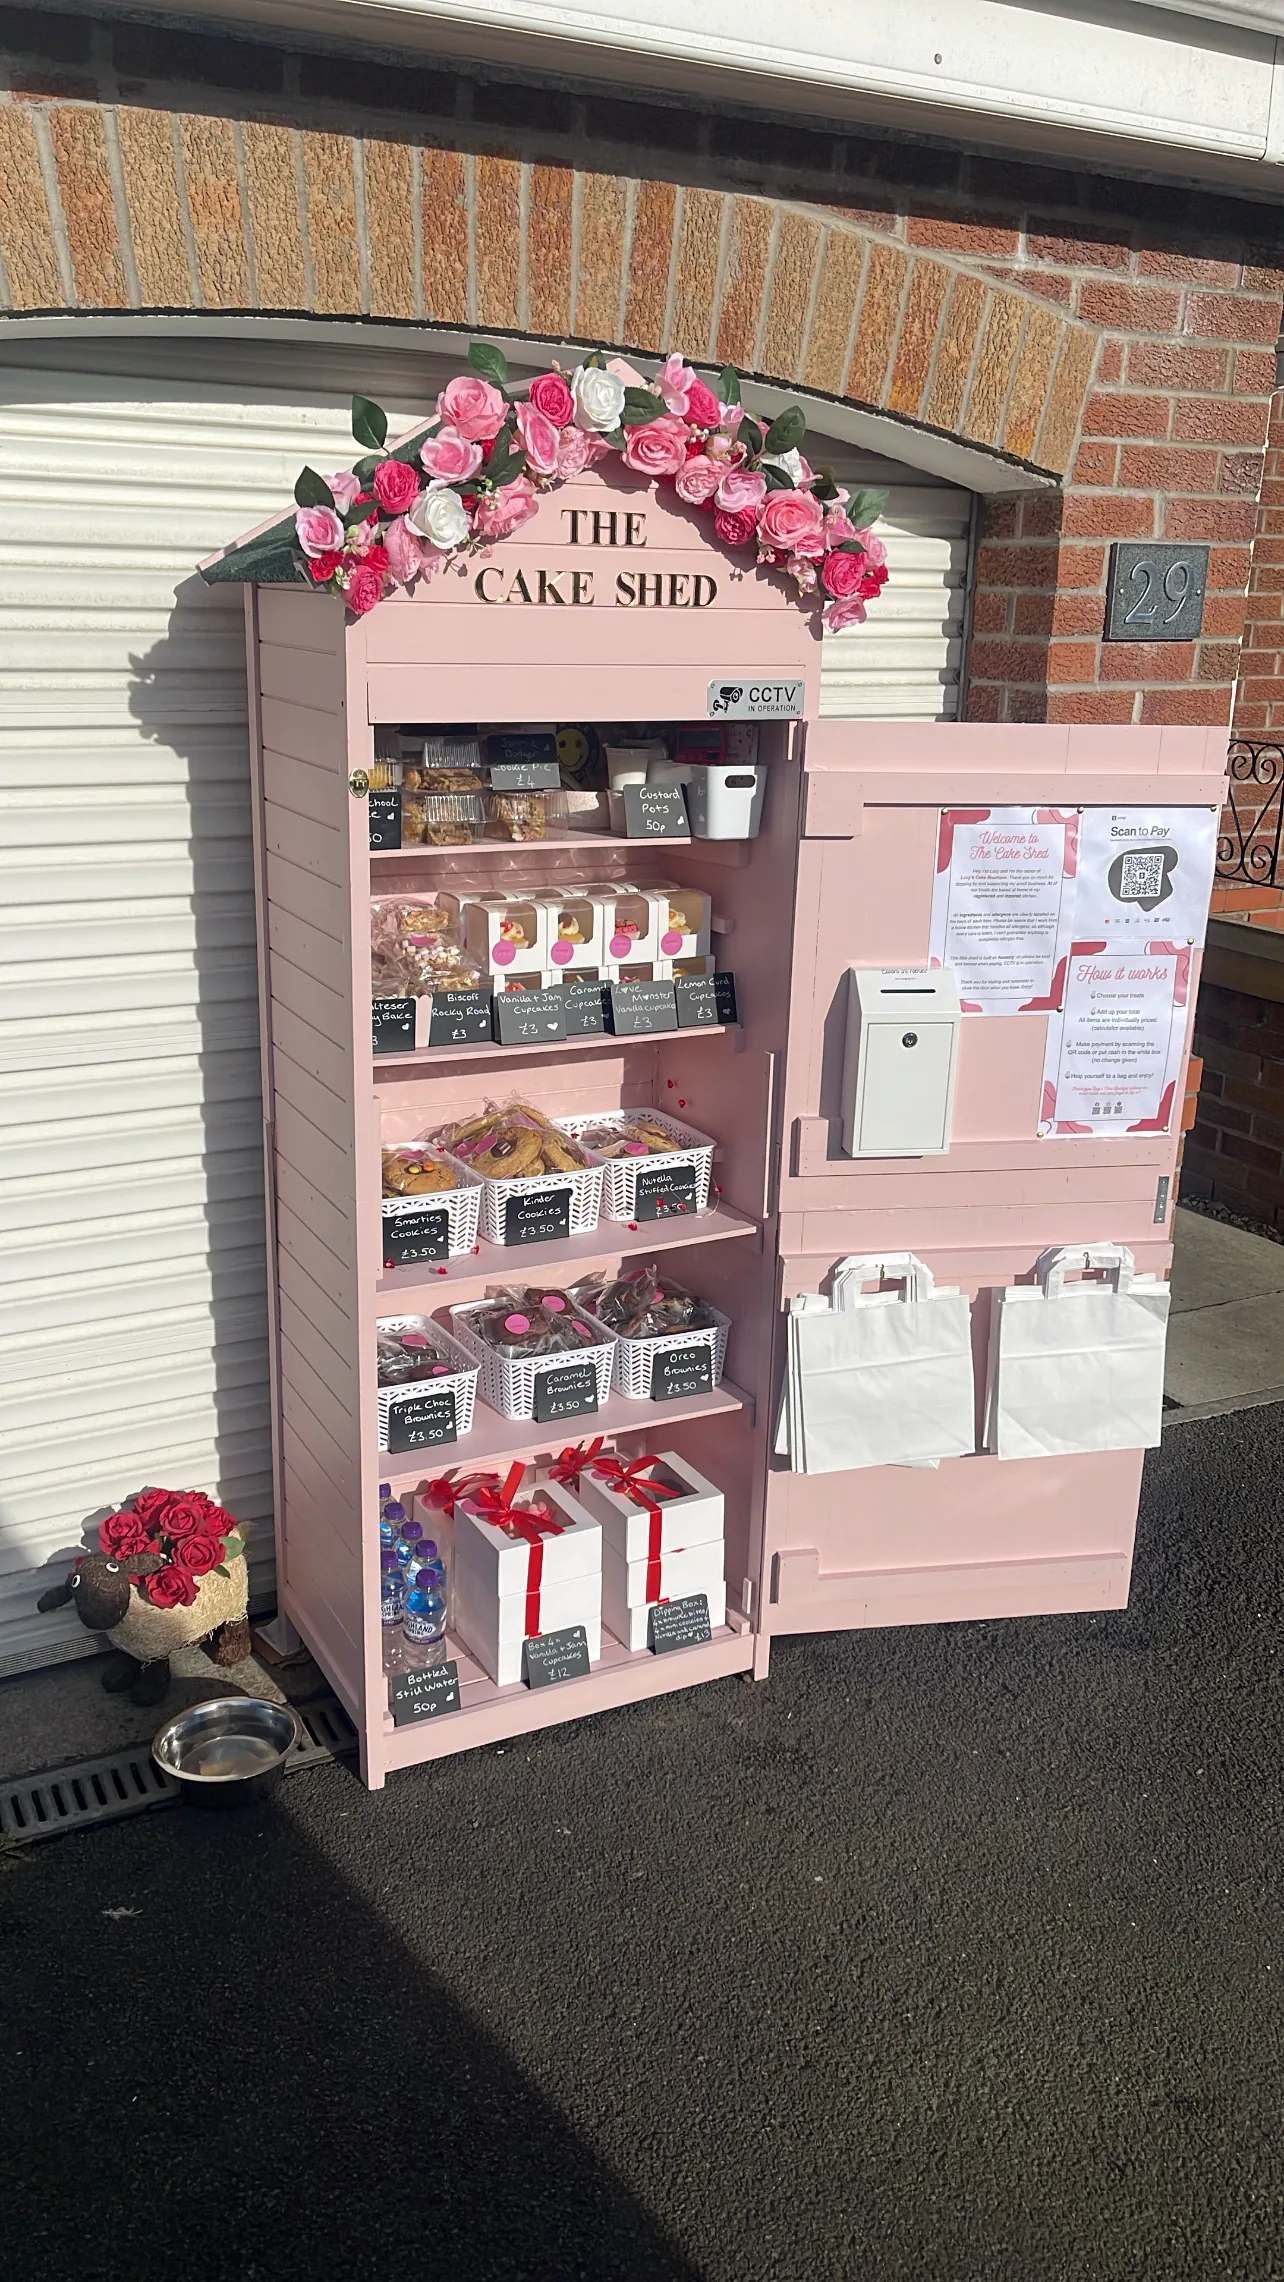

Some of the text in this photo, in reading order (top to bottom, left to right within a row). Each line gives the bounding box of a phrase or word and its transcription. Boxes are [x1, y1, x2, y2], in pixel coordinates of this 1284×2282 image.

[561, 509, 647, 547] THE
[475, 567, 718, 607] CAKE SHED
[1124, 560, 1194, 624] 29
[749, 687, 796, 703] CCTV
[494, 761, 551, 771] Cookie Pie
[516, 773, 535, 788] £4
[639, 787, 681, 800] Custard
[369, 796, 399, 807] chool
[642, 804, 669, 814] Pots
[645, 820, 666, 833] 50p
[1110, 825, 1170, 838] Scan to Pay
[979, 831, 1039, 844] Welcome to
[970, 846, 1049, 860] The Cake Shed
[1077, 964, 1168, 984] How it works
[570, 982, 608, 996] Caramel
[677, 976, 729, 989] Lemon Curd
[447, 993, 479, 1002] Biscoff
[499, 993, 562, 1004] Vanilla + Jam
[689, 992, 731, 1002] Cupcakes
[372, 1002, 409, 1010] lteser
[432, 1004, 490, 1021] Rocky Road
[513, 1004, 559, 1015] Cupcakes
[615, 1003, 644, 1013] Vanilla
[696, 1006, 713, 1019] £3
[382, 1013, 413, 1021] Bake
[580, 1015, 597, 1026] £3
[633, 1016, 653, 1029] £3
[452, 1029, 467, 1039] £3
[518, 1022, 539, 1035] £3
[372, 1035, 379, 1045] 3
[642, 1174, 672, 1186] Nutella
[639, 1184, 670, 1196] Stuffed
[523, 1194, 556, 1206] Kinder
[517, 1207, 562, 1220] Cookies
[394, 1214, 442, 1227] Smarties
[390, 1226, 438, 1239] Cookies
[520, 1224, 554, 1238] £3.50
[401, 1247, 437, 1259] £3.50
[670, 1353, 696, 1363] Oreo
[664, 1363, 707, 1376] Brownies
[547, 1368, 592, 1385] Caramel
[547, 1380, 591, 1394] Brownies
[393, 1399, 452, 1414] Triple Choc
[404, 1410, 451, 1424] Brownies
[408, 1429, 444, 1443] £3.50
[654, 1599, 703, 1616] Dipping Box:
[528, 1642, 546, 1651] Box
[566, 1640, 587, 1651] Jam
[542, 1651, 582, 1666] Cupcakes
[407, 1665, 449, 1685] Bottled
[548, 1667, 571, 1681] £12
[395, 1686, 422, 1700] Still
[413, 1702, 437, 1713] 50p
